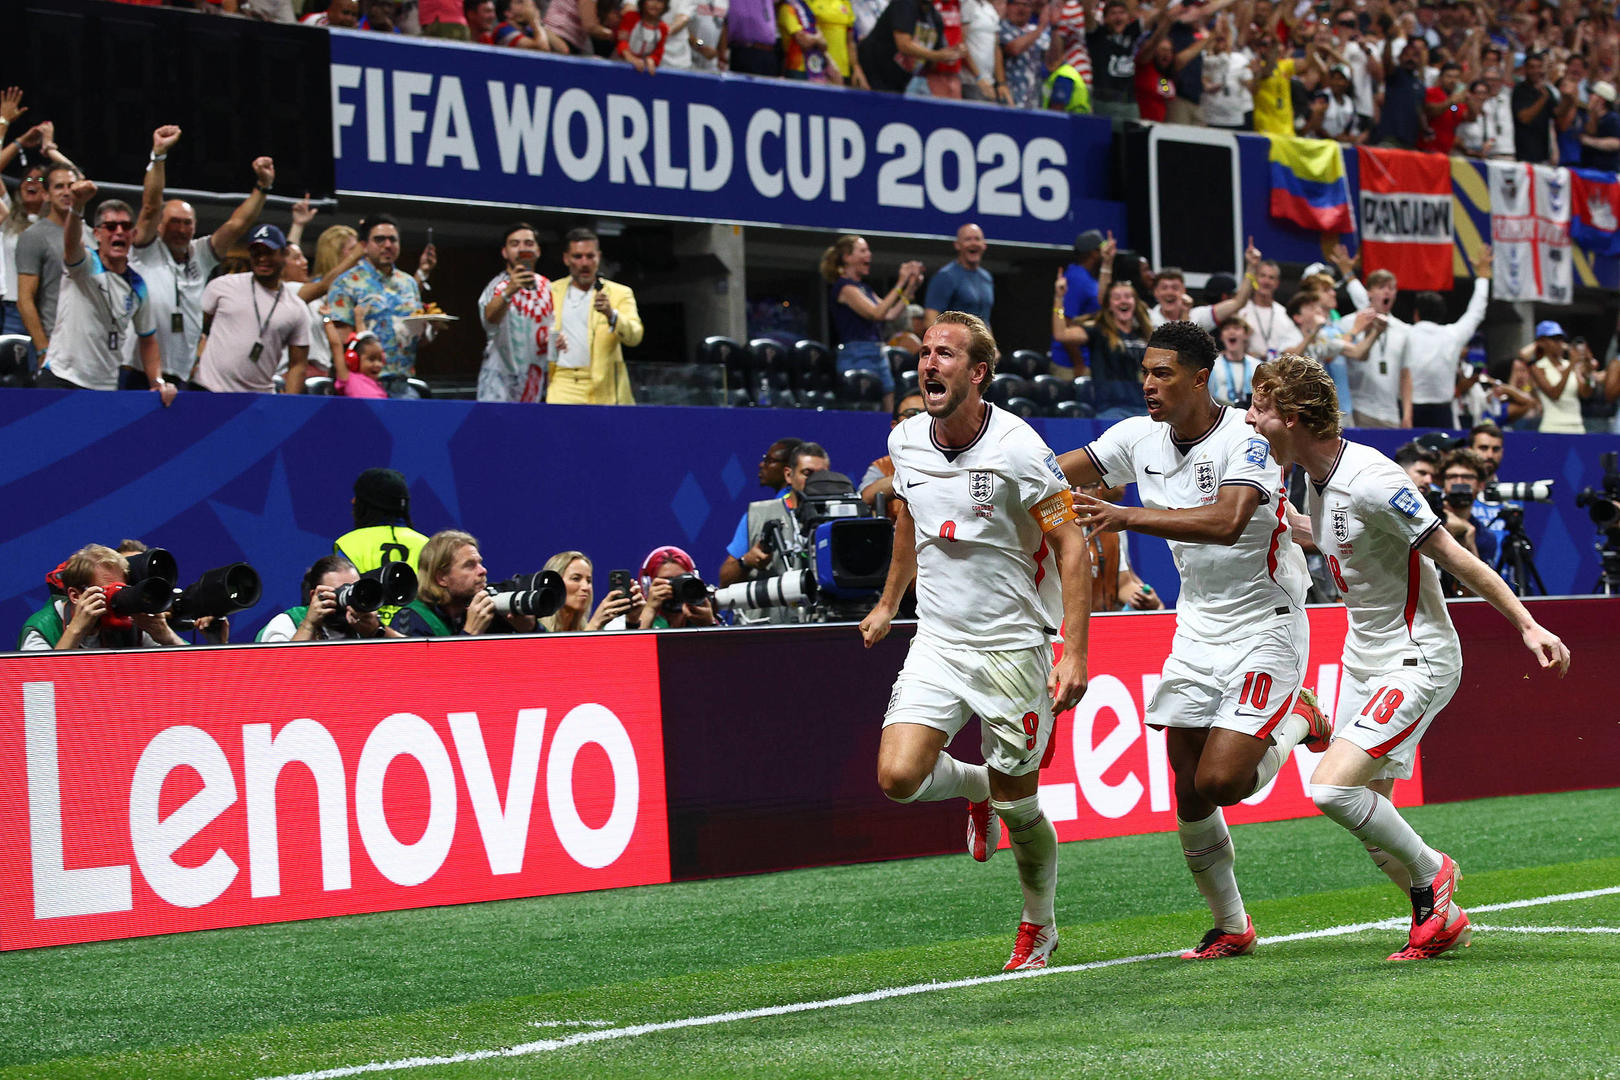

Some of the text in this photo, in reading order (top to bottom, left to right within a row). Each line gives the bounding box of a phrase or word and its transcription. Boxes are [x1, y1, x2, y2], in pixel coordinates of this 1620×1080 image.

[330, 63, 1070, 221] FIFA WORLD CUP 2026
[1040, 501, 1065, 517] UNITES
[1238, 671, 1273, 710] 10
[1360, 685, 1405, 725] 18
[1022, 711, 1040, 751] 9
[22, 681, 640, 920] Lenovo
